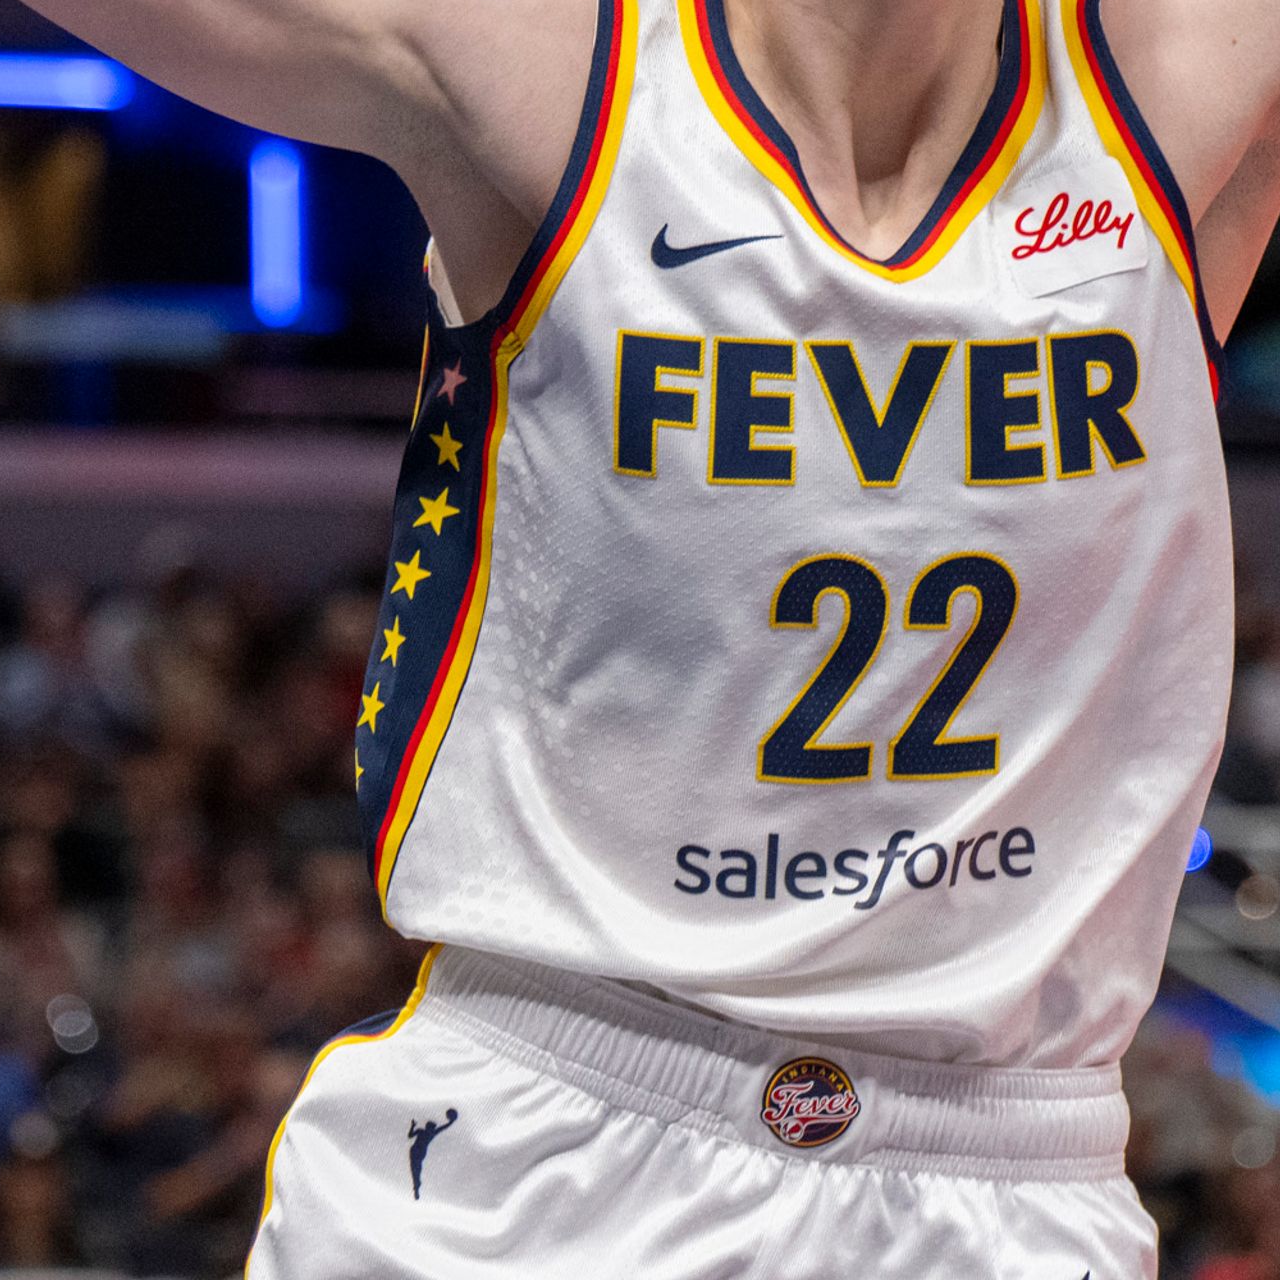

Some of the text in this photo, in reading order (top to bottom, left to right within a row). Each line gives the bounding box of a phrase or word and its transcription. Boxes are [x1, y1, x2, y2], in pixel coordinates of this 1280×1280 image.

[1011, 191, 1134, 260] Lilly
[613, 328, 1147, 487] FEVER
[755, 551, 1020, 784] 22
[673, 826, 1035, 910] salesforce
[762, 1080, 860, 1124] Fever
[781, 1065, 845, 1092] INDIANA
